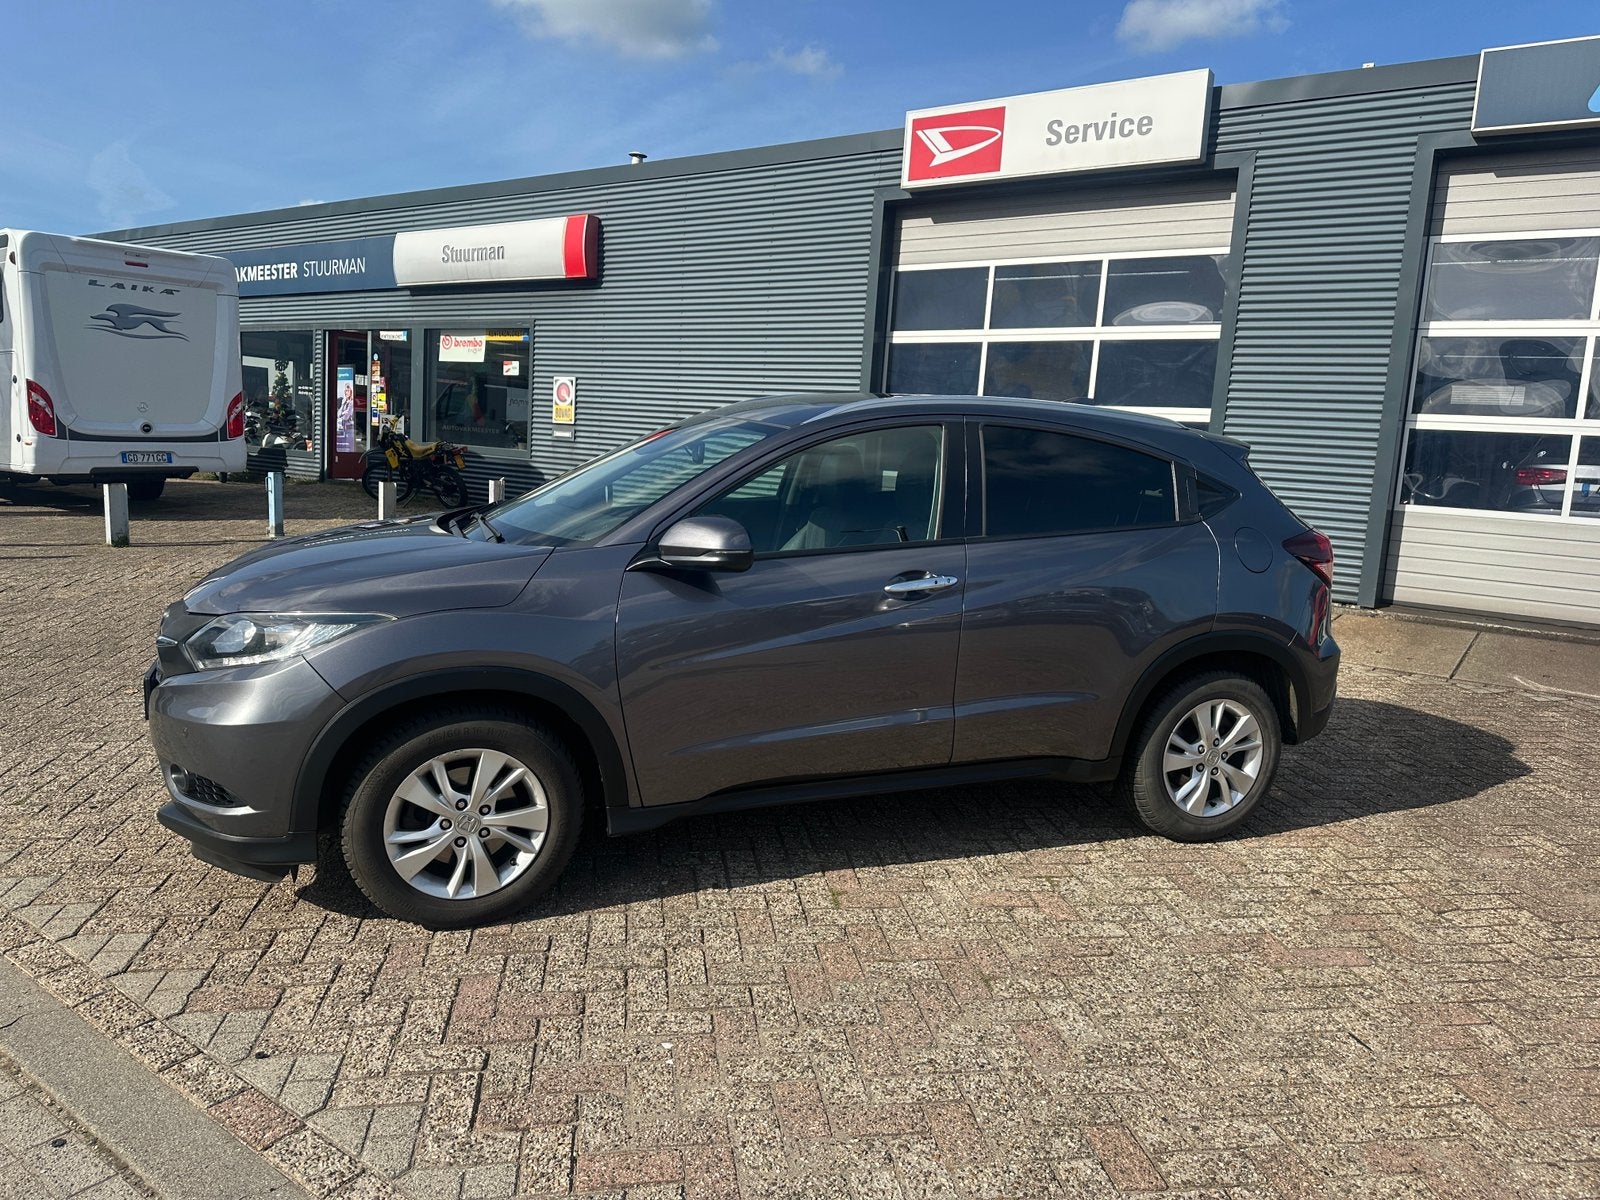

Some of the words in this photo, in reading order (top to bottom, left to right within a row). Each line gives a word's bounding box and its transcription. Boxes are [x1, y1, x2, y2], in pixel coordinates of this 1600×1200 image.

[1045, 112, 1153, 146] Service
[441, 244, 505, 264] Stuurman
[303, 256, 366, 278] STUURMAN
[88, 279, 181, 296] LAIKA
[453, 337, 483, 348] brembo
